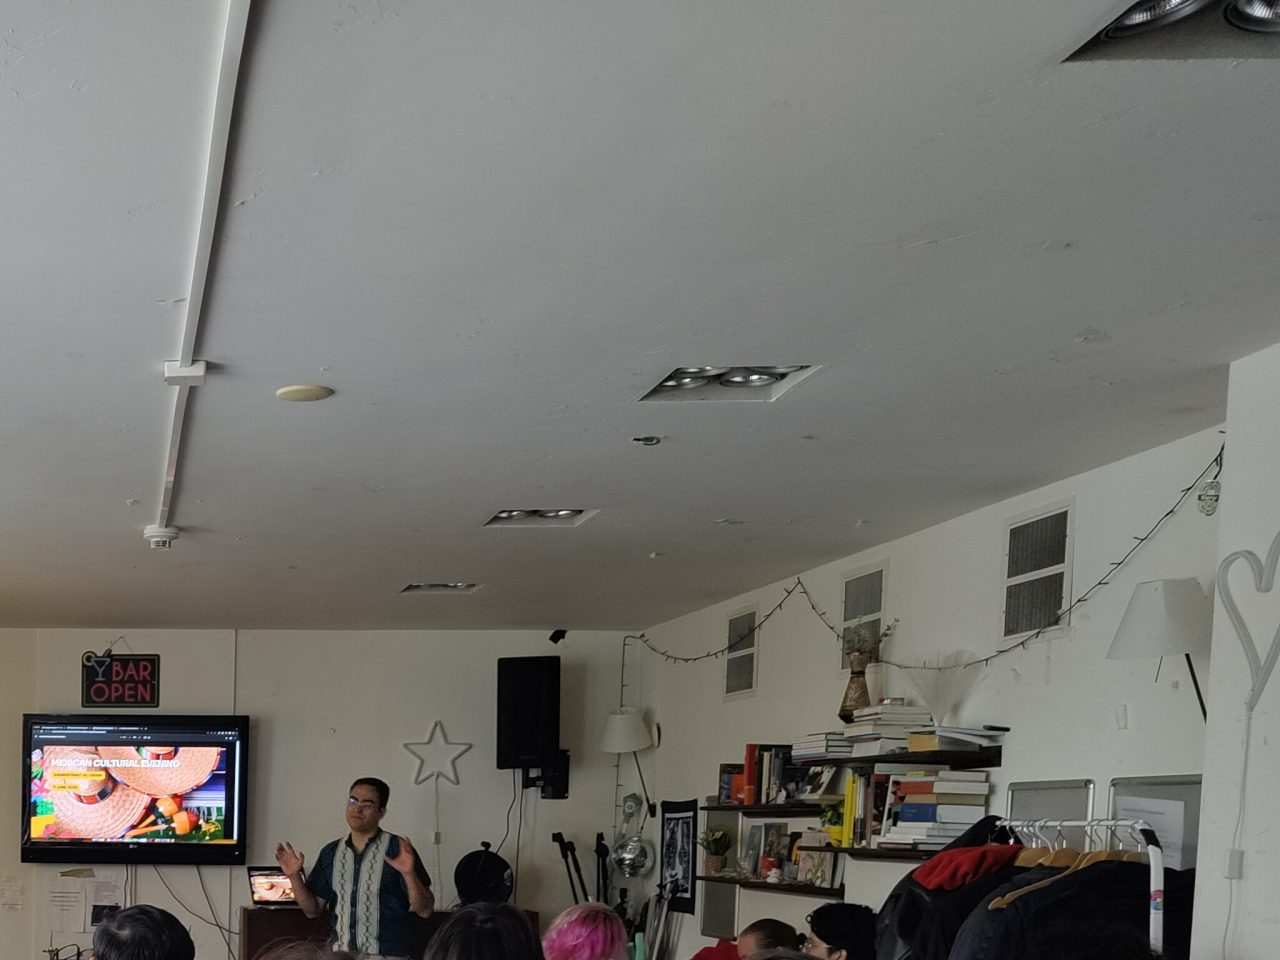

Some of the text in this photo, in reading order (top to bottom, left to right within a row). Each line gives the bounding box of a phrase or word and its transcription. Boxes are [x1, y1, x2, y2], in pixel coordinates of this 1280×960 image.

[112, 661, 151, 681] BAR
[90, 683, 152, 702] OPEN
[51, 759, 180, 768] MEXICAN CULTURAL EVENING
